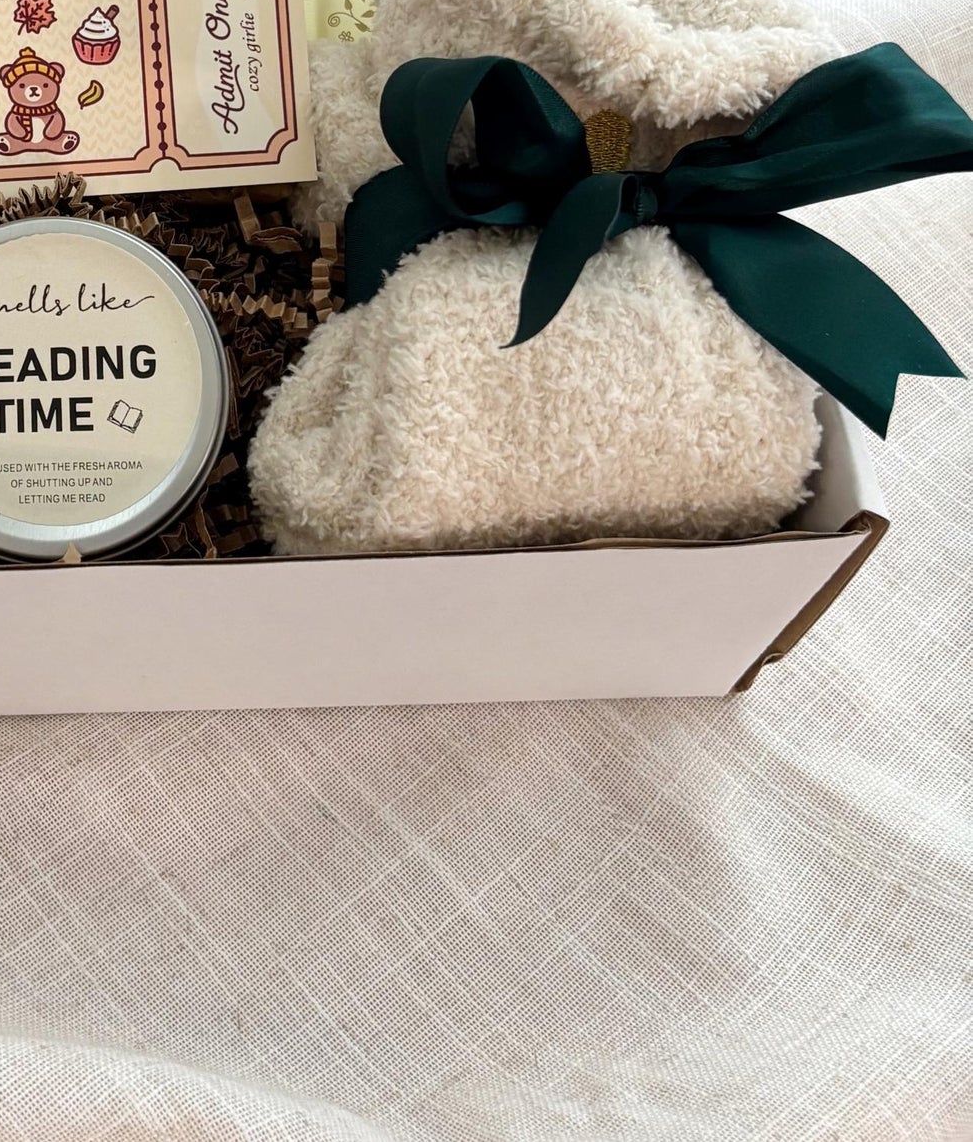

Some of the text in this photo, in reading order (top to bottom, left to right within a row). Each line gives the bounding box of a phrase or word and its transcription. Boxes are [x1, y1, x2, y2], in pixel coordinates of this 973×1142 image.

[240, 12, 263, 92] cozy girlie
[211, 49, 245, 135] Admit
[77, 282, 155, 313] like
[25, 462, 50, 472] WITH
[51, 462, 71, 471] THE
[72, 461, 106, 471] FRESH
[107, 460, 143, 470] AROMA
[10, 477, 113, 489] OF SHUTTING UP AND
[18, 493, 106, 504] LETTING ME READ
